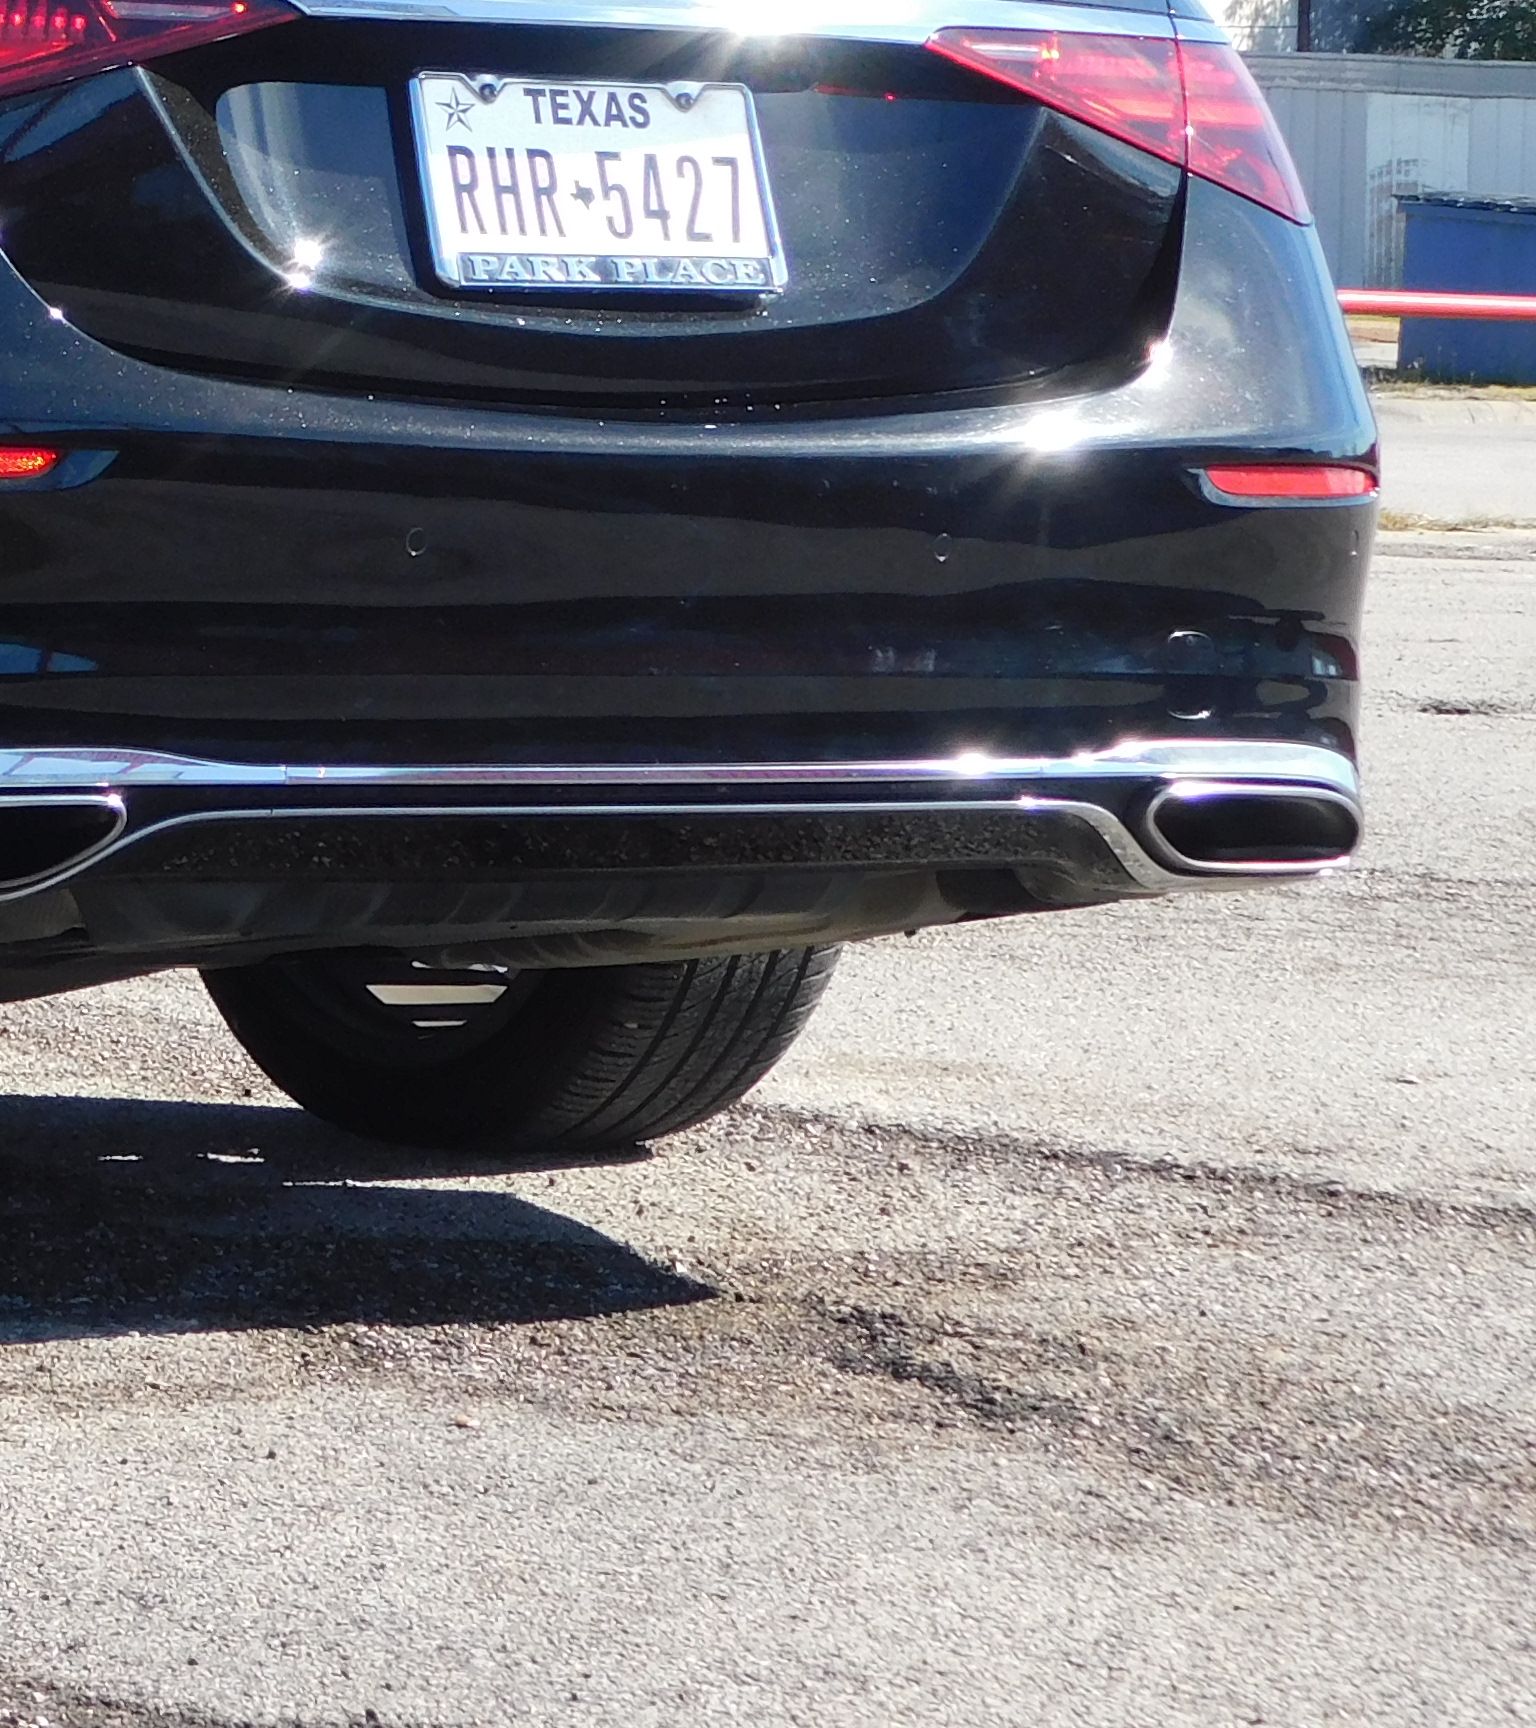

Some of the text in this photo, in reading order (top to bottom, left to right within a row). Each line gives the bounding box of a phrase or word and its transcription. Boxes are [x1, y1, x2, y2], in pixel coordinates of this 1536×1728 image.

[522, 87, 651, 129] TEXAS
[469, 254, 766, 286] PARK PLACE
